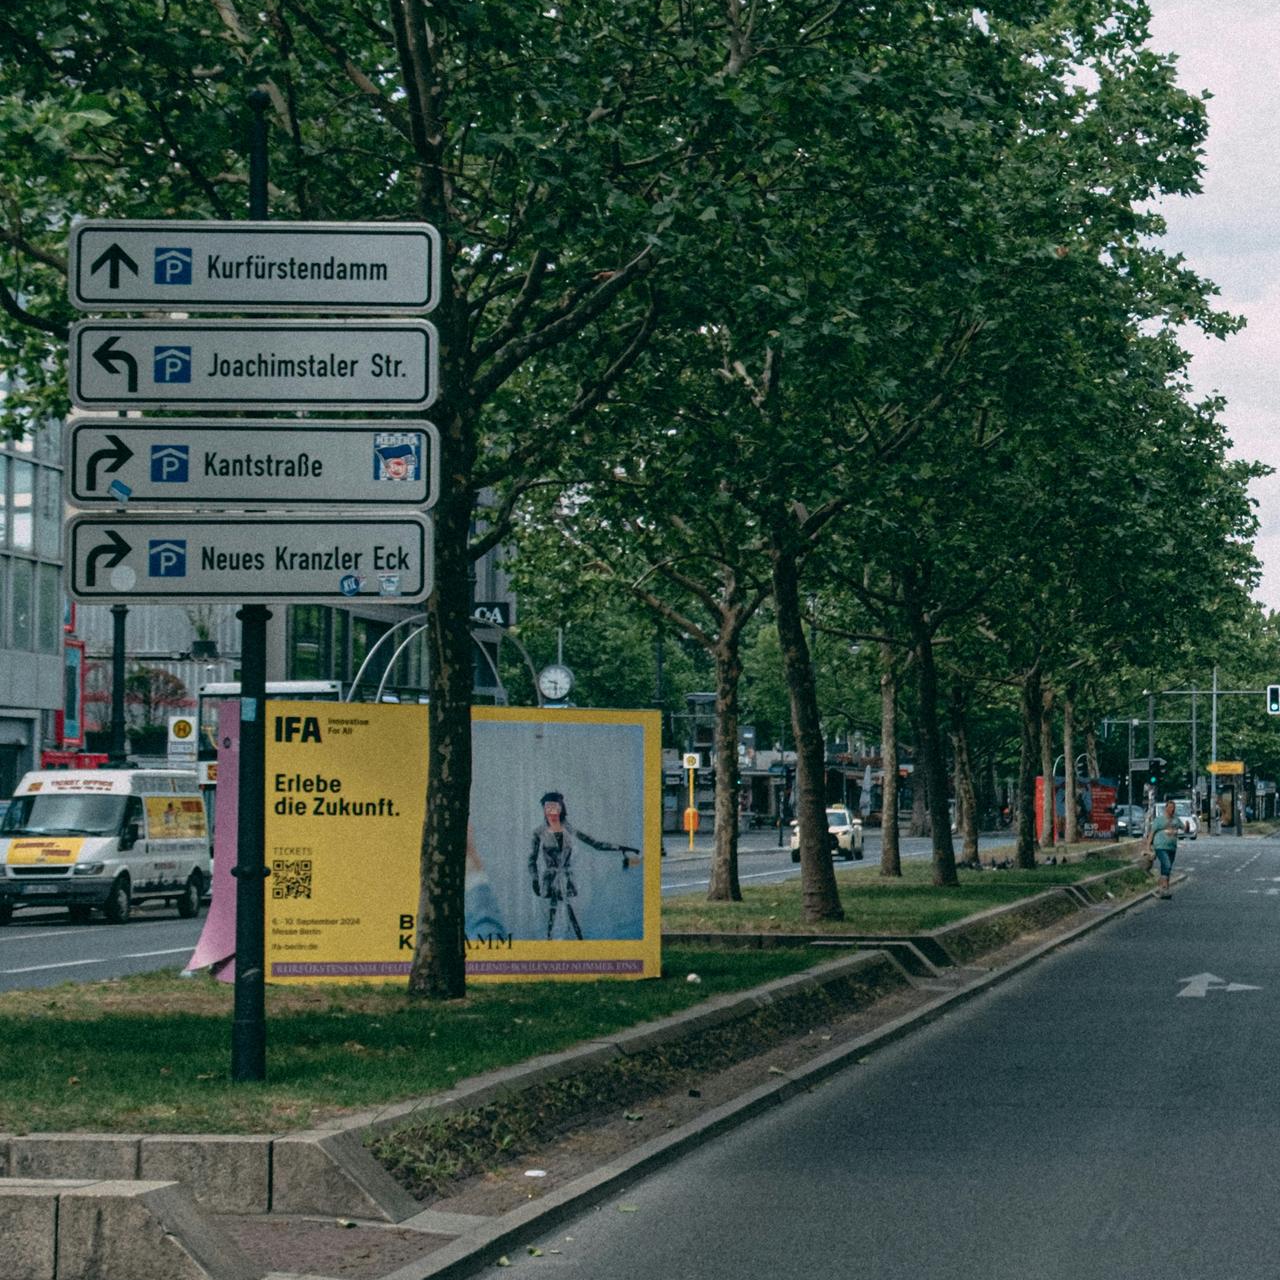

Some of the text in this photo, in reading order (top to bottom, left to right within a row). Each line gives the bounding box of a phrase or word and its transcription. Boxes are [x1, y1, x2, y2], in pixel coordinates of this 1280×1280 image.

[207, 255, 388, 281] Kurfürstendamm
[207, 353, 358, 377] Joachimstaler
[370, 353, 407, 378] Str.
[204, 451, 323, 477] Kantstraße
[201, 546, 265, 571] Neues
[275, 546, 363, 571] Kranzler
[373, 546, 410, 570] Eck
[275, 716, 322, 743] IFA
[275, 774, 341, 793] Erlebe
[275, 797, 400, 816] die Zukunft.
[273, 847, 312, 856] TICKETS
[296, 918, 338, 926] September
